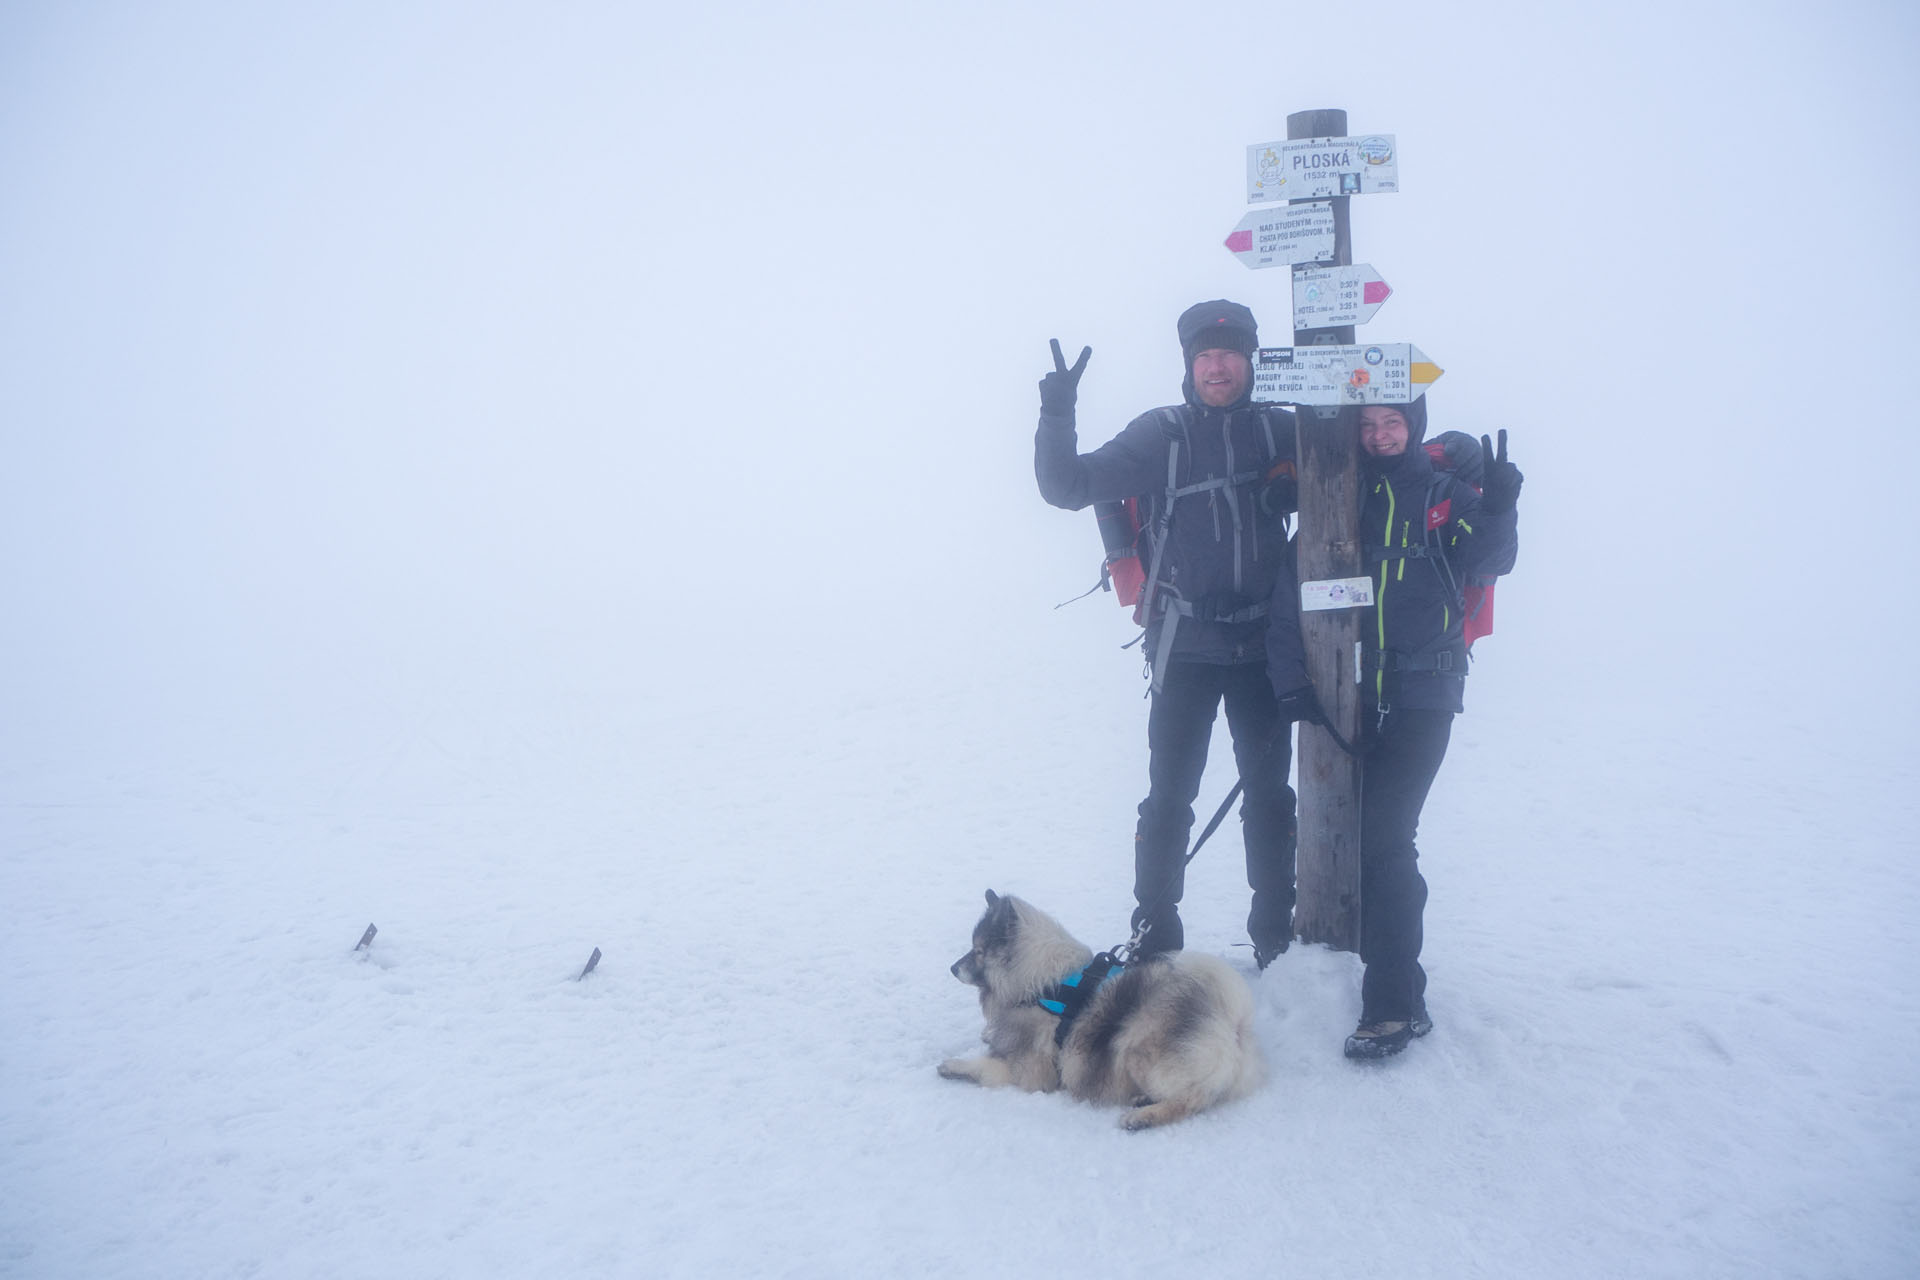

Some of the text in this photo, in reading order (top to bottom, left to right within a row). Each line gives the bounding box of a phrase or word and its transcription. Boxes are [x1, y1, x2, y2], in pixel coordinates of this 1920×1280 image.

[1293, 149, 1350, 170] PLOSKÁ
[1304, 171, 1326, 181] (1532
[1275, 218, 1311, 230] STUDENÝM
[1260, 234, 1276, 243] CHATA
[1278, 233, 1288, 241] POD
[1298, 306, 1315, 314] HOTEL
[1279, 362, 1304, 370] PLOSKEJ
[1256, 383, 1275, 392] VYŠNÁ
[1279, 383, 1302, 391] REVÚCA
